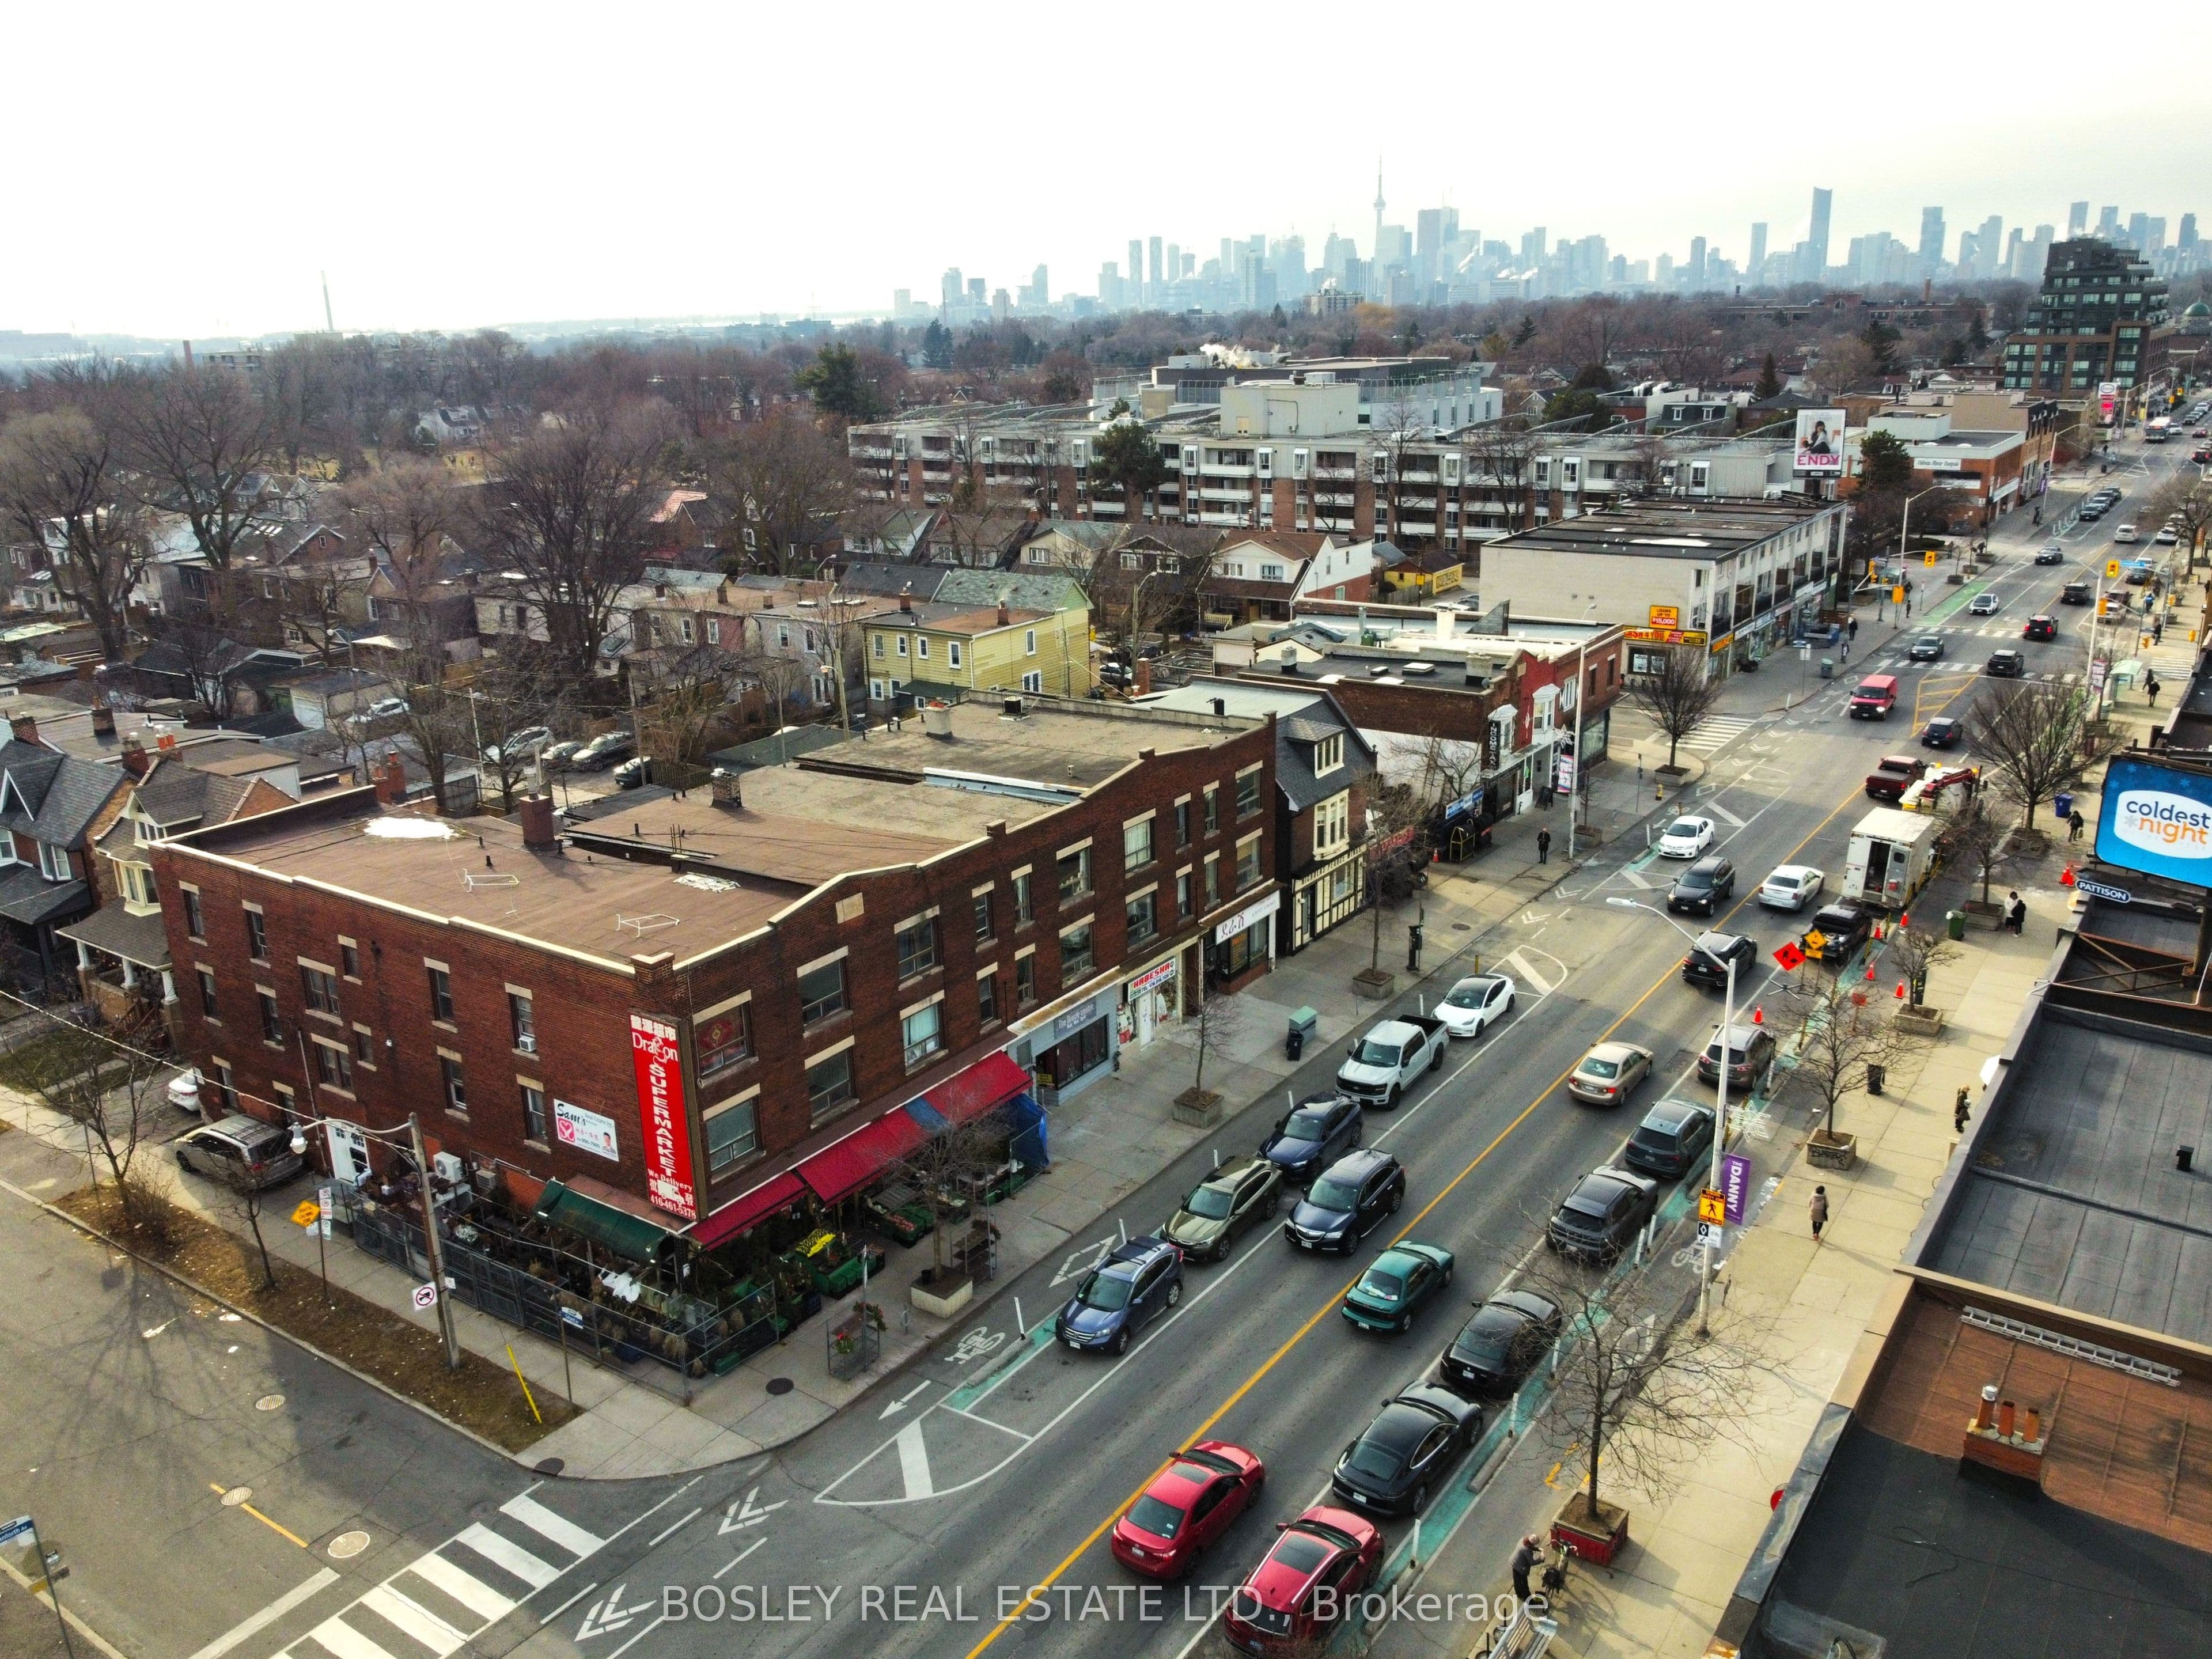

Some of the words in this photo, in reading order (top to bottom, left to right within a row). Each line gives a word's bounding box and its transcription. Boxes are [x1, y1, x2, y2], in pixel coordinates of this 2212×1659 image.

[1797, 455, 1840, 465] ENDY
[1652, 617, 1675, 625] $15,000
[1489, 722, 1497, 751] INCOME
[1488, 751, 1497, 766] TAX
[2126, 801, 2211, 829] coldest
[2138, 817, 2209, 844] night
[2079, 881, 2127, 902] PATTISON
[1133, 962, 1170, 989] HABESHA
[557, 1103, 586, 1126] Sam's
[649, 1063, 677, 1177] SUPERMARKET
[647, 1168, 660, 1179] We
[660, 1173, 692, 1192] Delivery
[1726, 1165, 1743, 1213] DANNY
[650, 1194, 696, 1219] 416-461-5378
